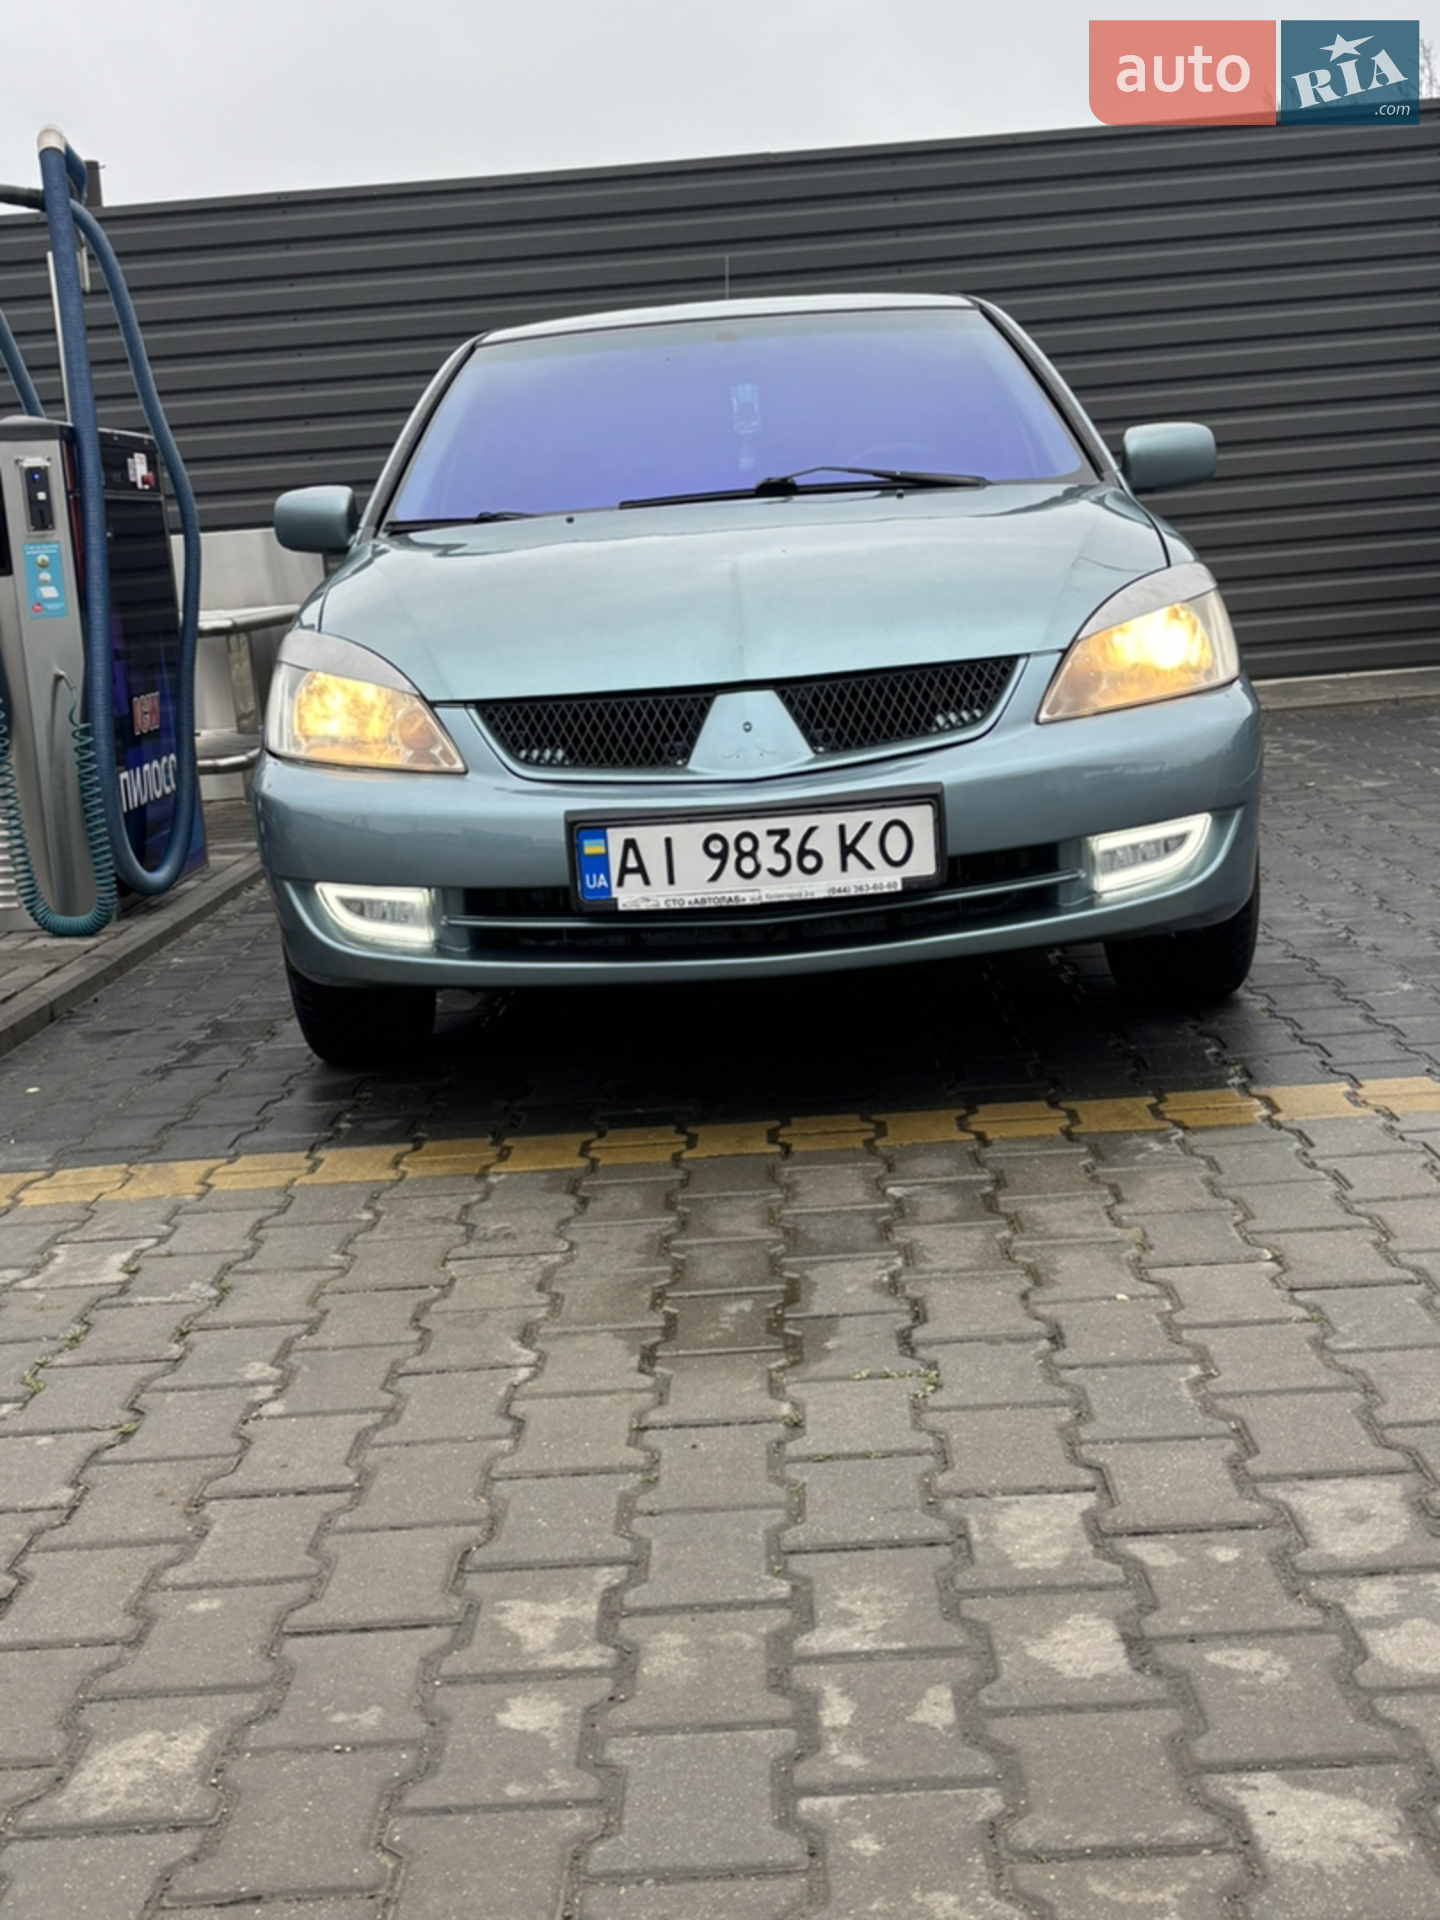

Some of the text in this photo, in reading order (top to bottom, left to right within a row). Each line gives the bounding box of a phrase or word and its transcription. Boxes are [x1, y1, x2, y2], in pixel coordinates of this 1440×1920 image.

[119, 752, 177, 813] ПИЛОСО
[585, 872, 609, 889] UA
[616, 818, 914, 888] AI 9836 KO
